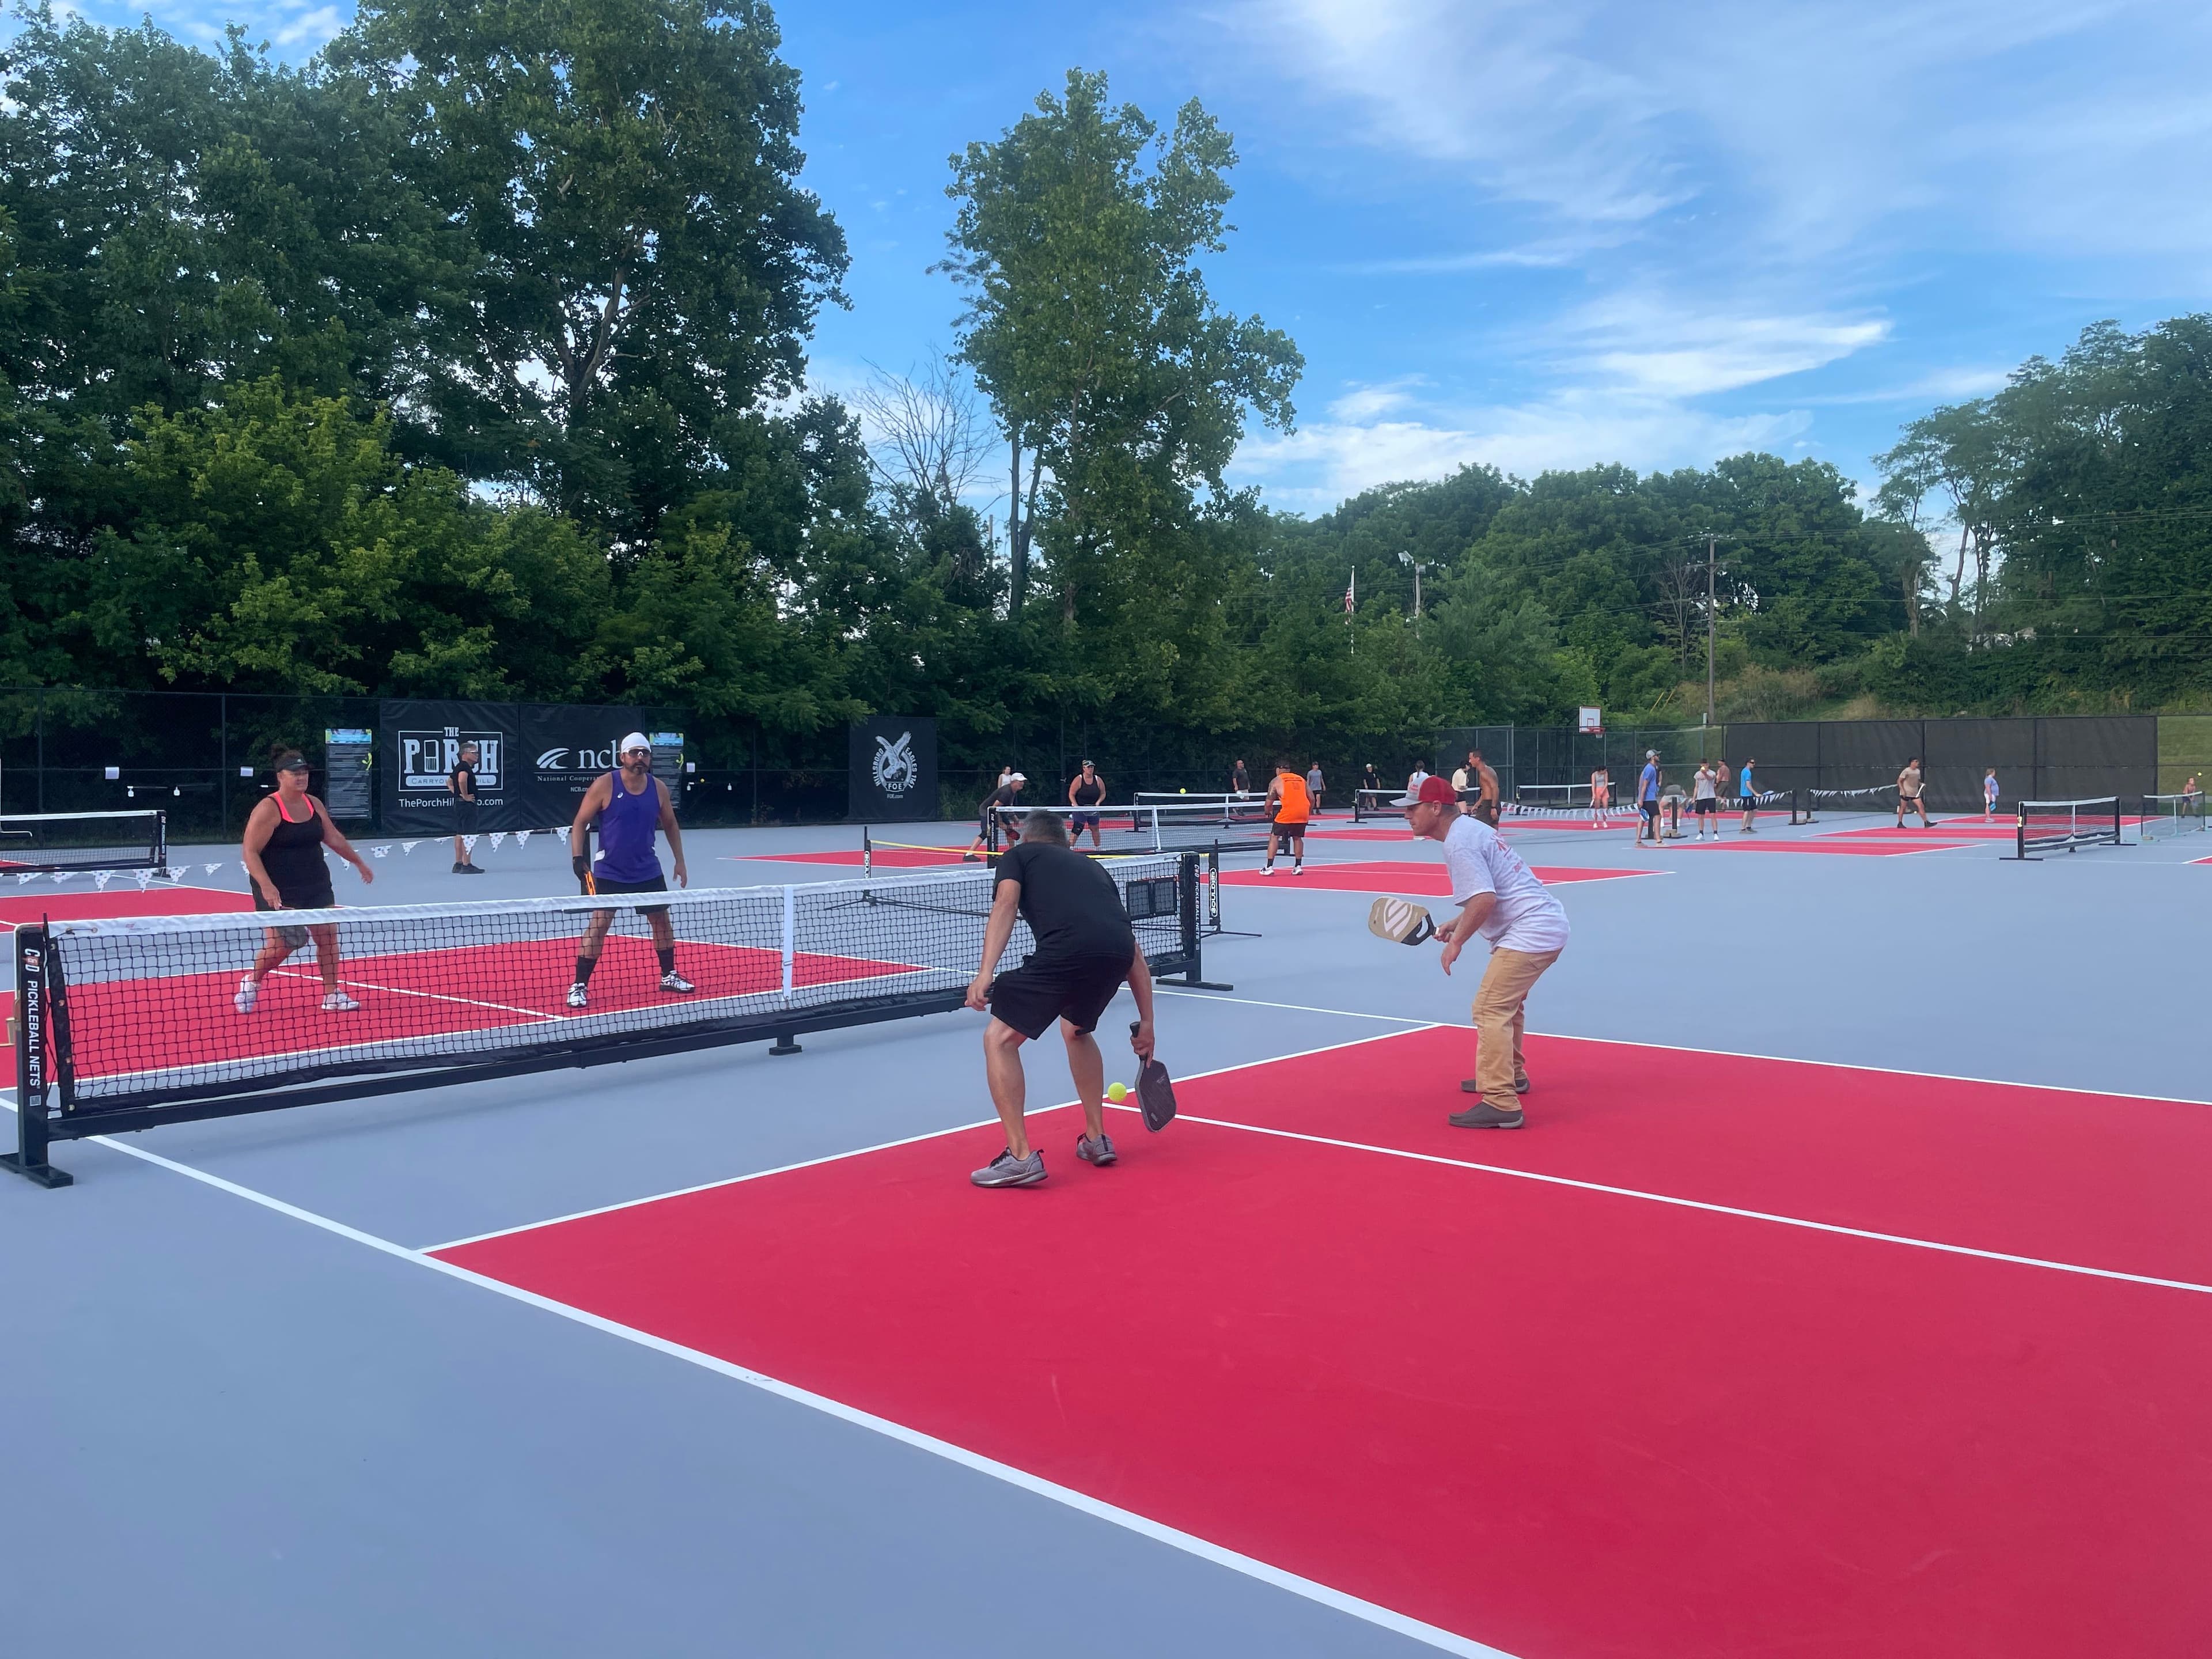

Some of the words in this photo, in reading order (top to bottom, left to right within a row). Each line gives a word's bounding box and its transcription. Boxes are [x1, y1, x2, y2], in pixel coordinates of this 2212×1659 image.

[444, 727, 459, 737] THE
[872, 748, 884, 787] HILLSBORO
[905, 747, 918, 772] EAGLES
[399, 798, 503, 808] ThePorchHilo.com
[27, 980, 39, 1052] PICKLEBALL
[29, 1055, 40, 1086] NETS
